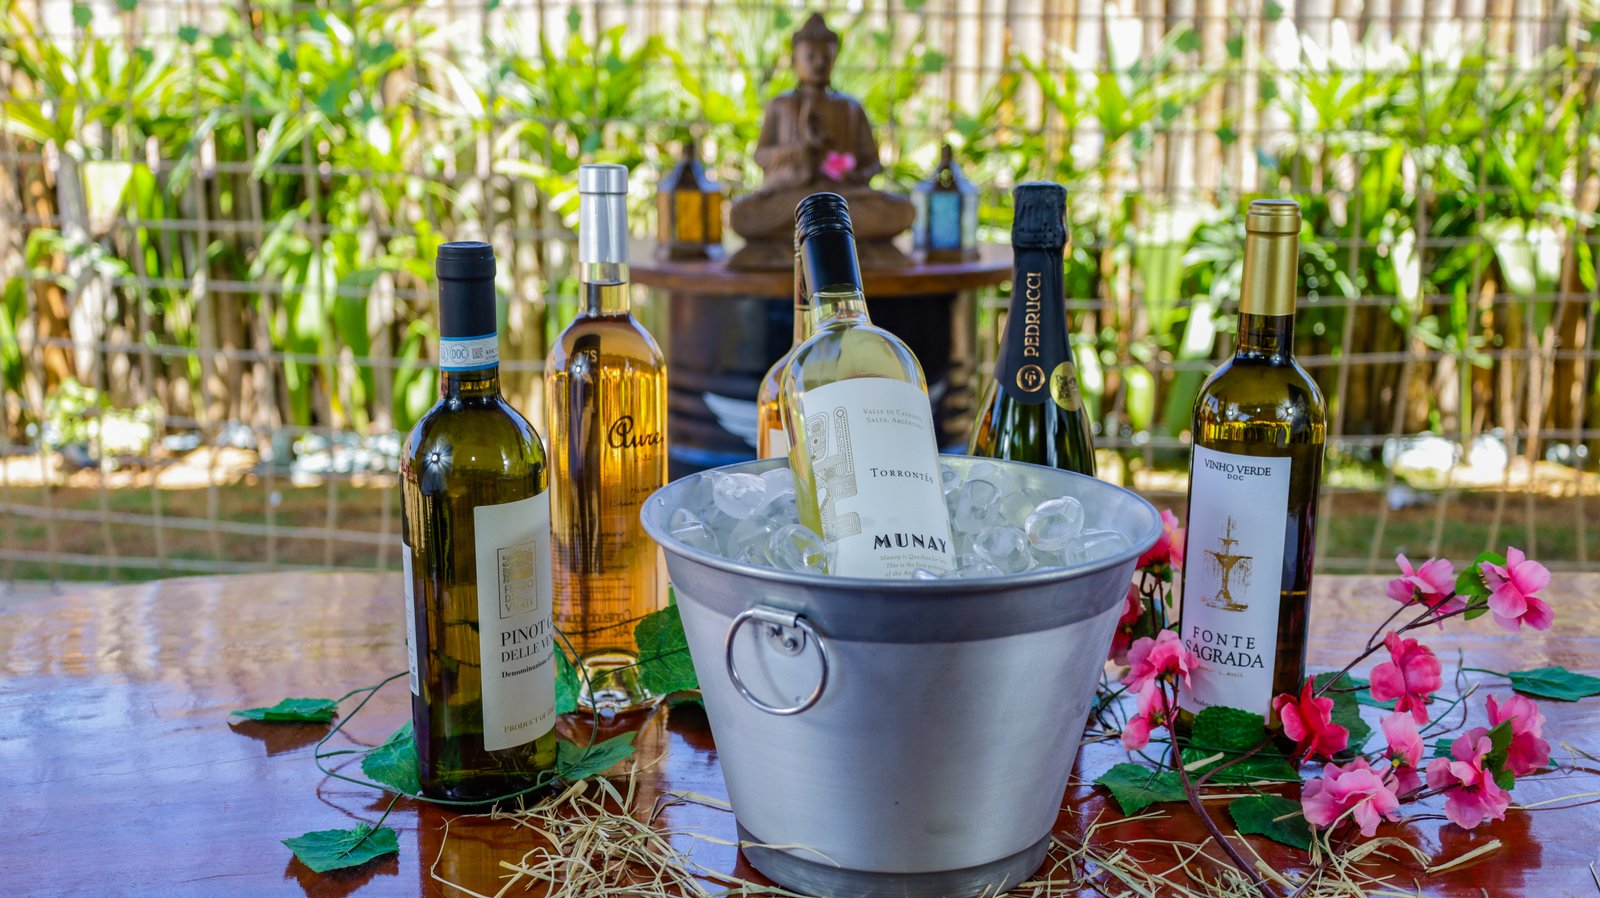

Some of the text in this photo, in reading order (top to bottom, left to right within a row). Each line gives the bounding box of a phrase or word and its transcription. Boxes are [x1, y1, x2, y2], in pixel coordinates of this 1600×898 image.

[1023, 272, 1041, 357] PEDRUCCI
[1204, 458, 1272, 476] VINHO VERDE
[1227, 473, 1245, 481] DOC
[873, 532, 946, 554] MUNAY
[500, 619, 546, 647] PINOT
[1193, 626, 1256, 649] FONTE
[501, 642, 540, 662] DELLE
[1185, 639, 1265, 669] SAGRADA
[503, 716, 539, 733] PRODUCT
